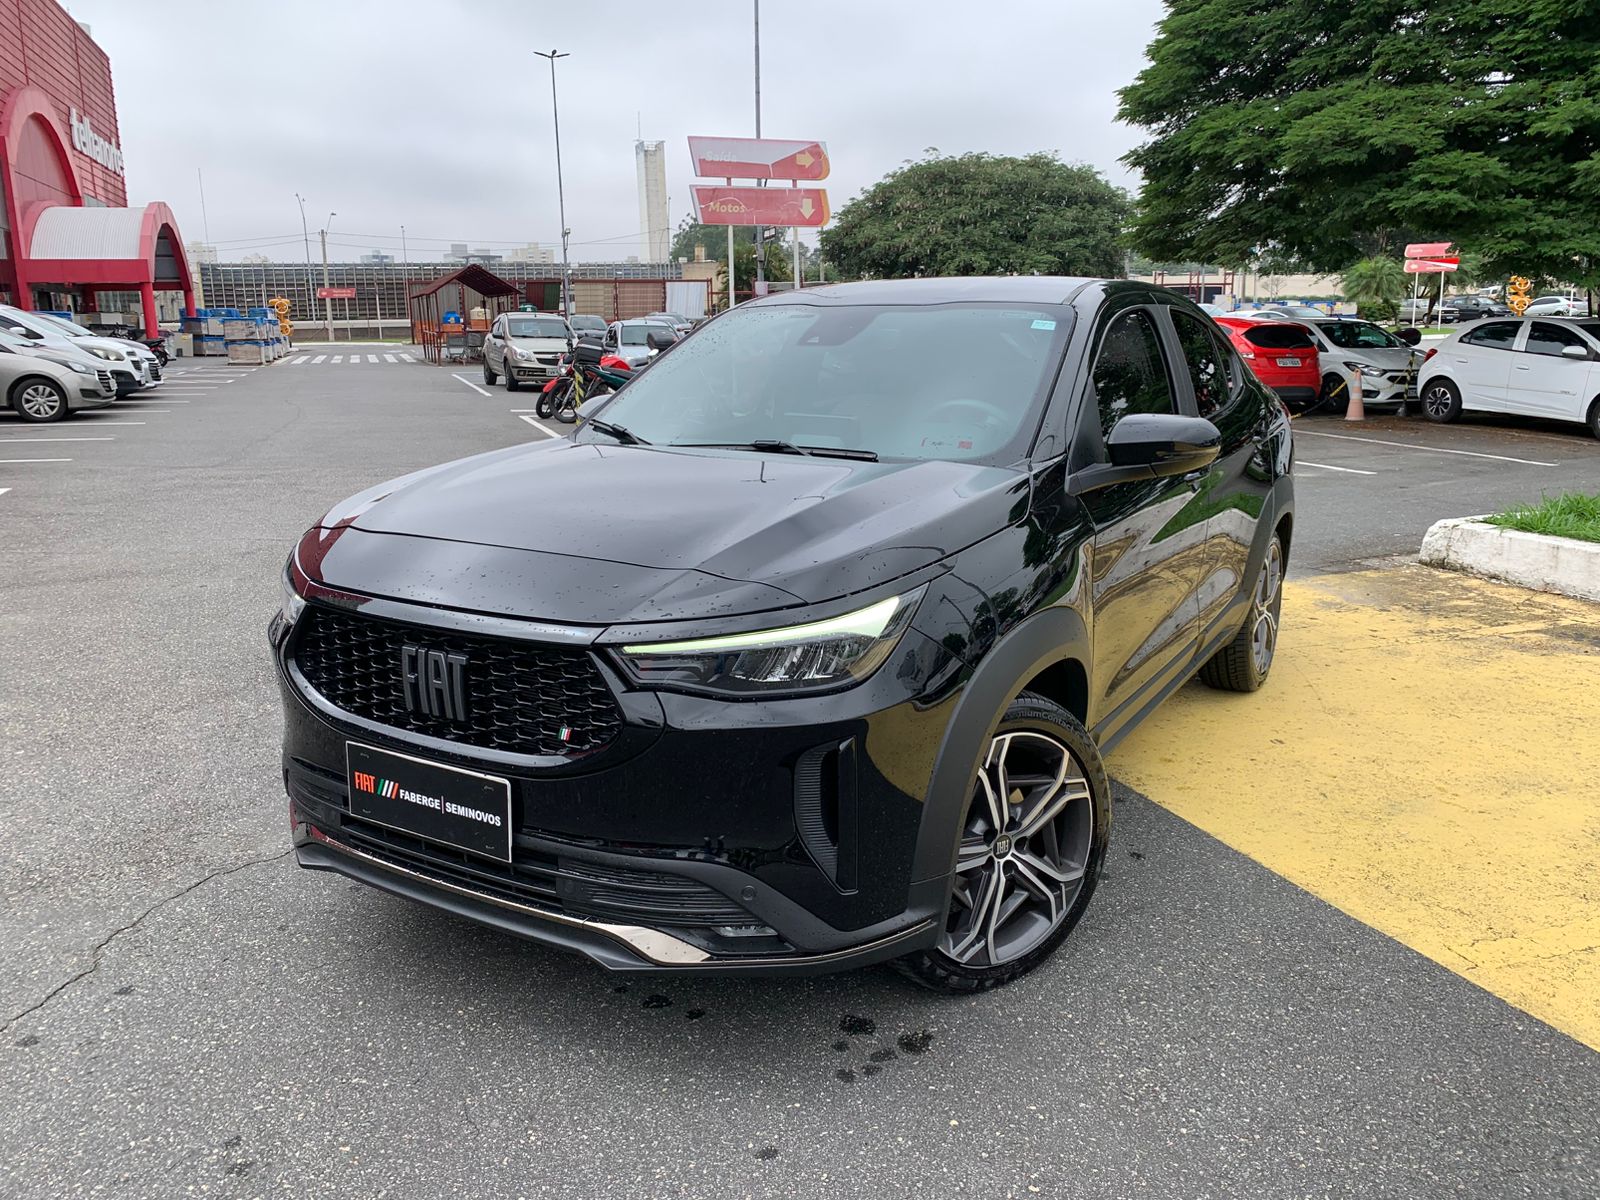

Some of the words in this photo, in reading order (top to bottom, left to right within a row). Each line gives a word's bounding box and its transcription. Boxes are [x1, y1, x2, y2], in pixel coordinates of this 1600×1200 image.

[70, 107, 125, 177] telhanorte
[708, 202, 745, 213] Motos
[401, 645, 468, 721] FIAT
[354, 771, 375, 793] FIAT
[400, 788, 441, 809] FABERGE
[445, 803, 501, 827] SEMINOVOS
